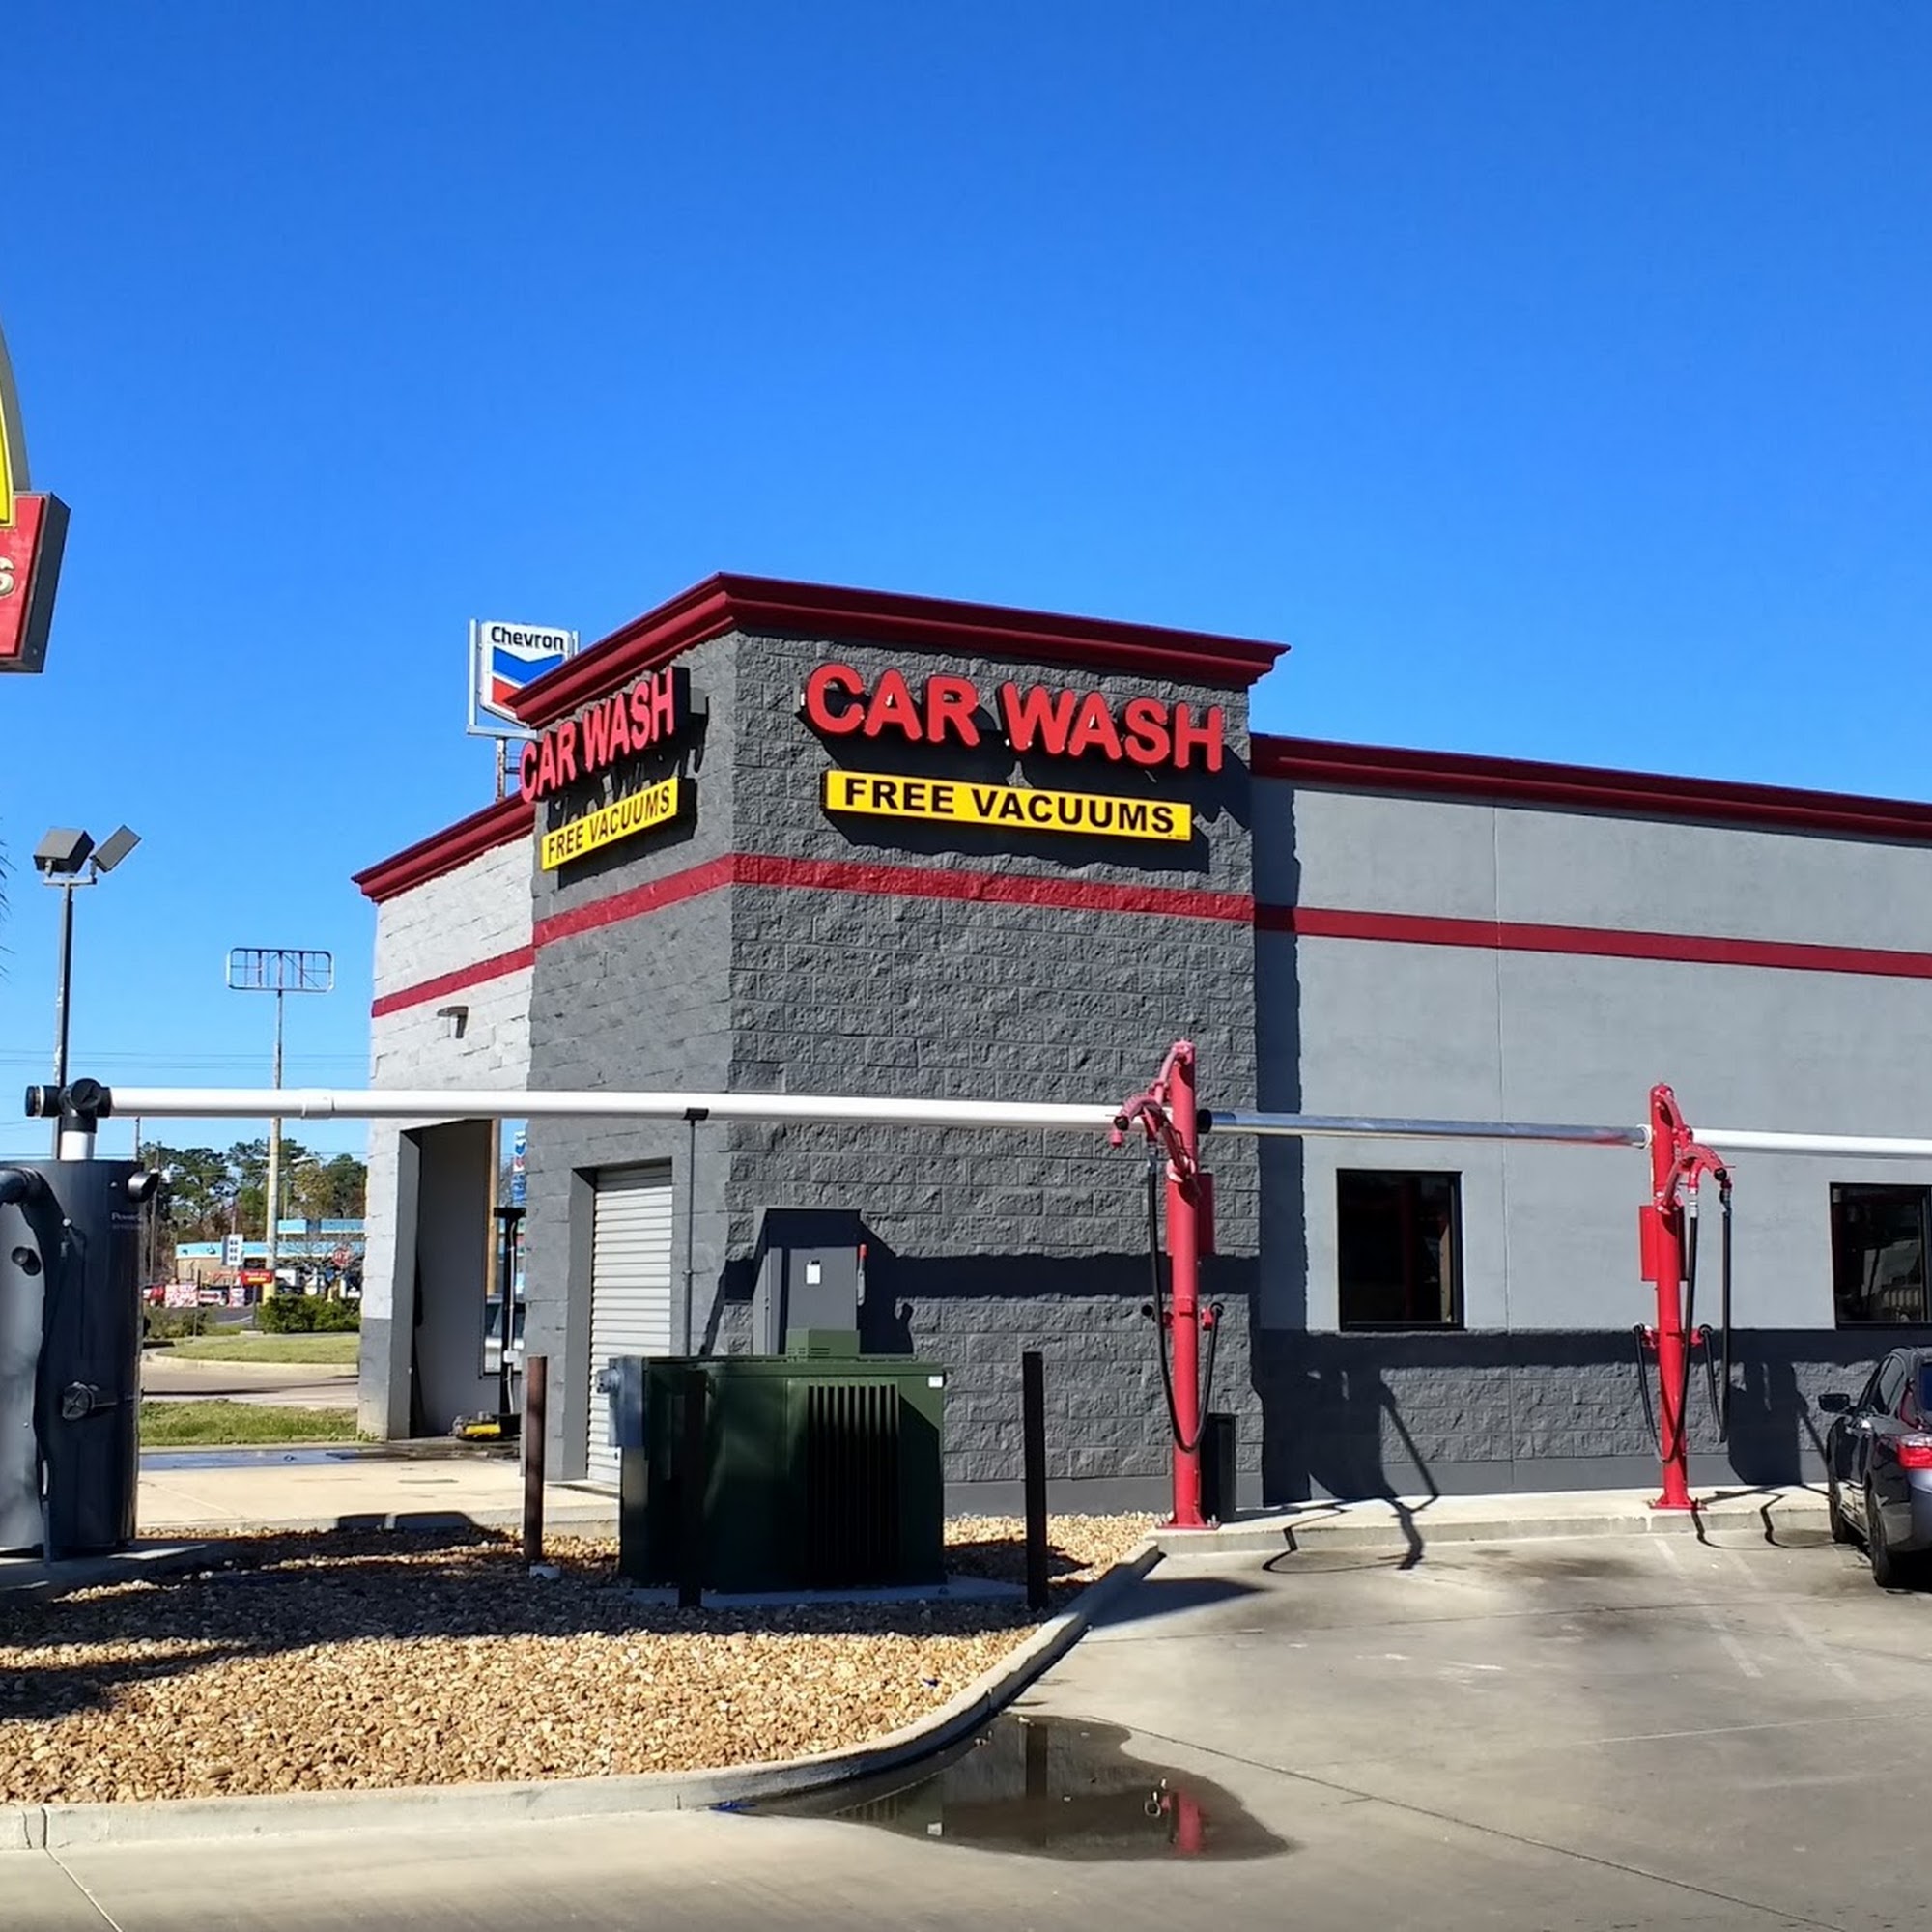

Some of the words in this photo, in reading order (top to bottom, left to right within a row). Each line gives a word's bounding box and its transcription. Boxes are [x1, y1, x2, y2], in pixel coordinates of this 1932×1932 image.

[491, 626, 564, 651] Chevron
[520, 721, 577, 803] CAR
[582, 666, 675, 773] WASH
[806, 663, 980, 747] CAR
[1001, 681, 1224, 772] WASH
[548, 823, 584, 864] FREE
[589, 785, 670, 843] VACUUMS
[845, 778, 955, 814] FREE
[972, 788, 1175, 834] VACUUMS
